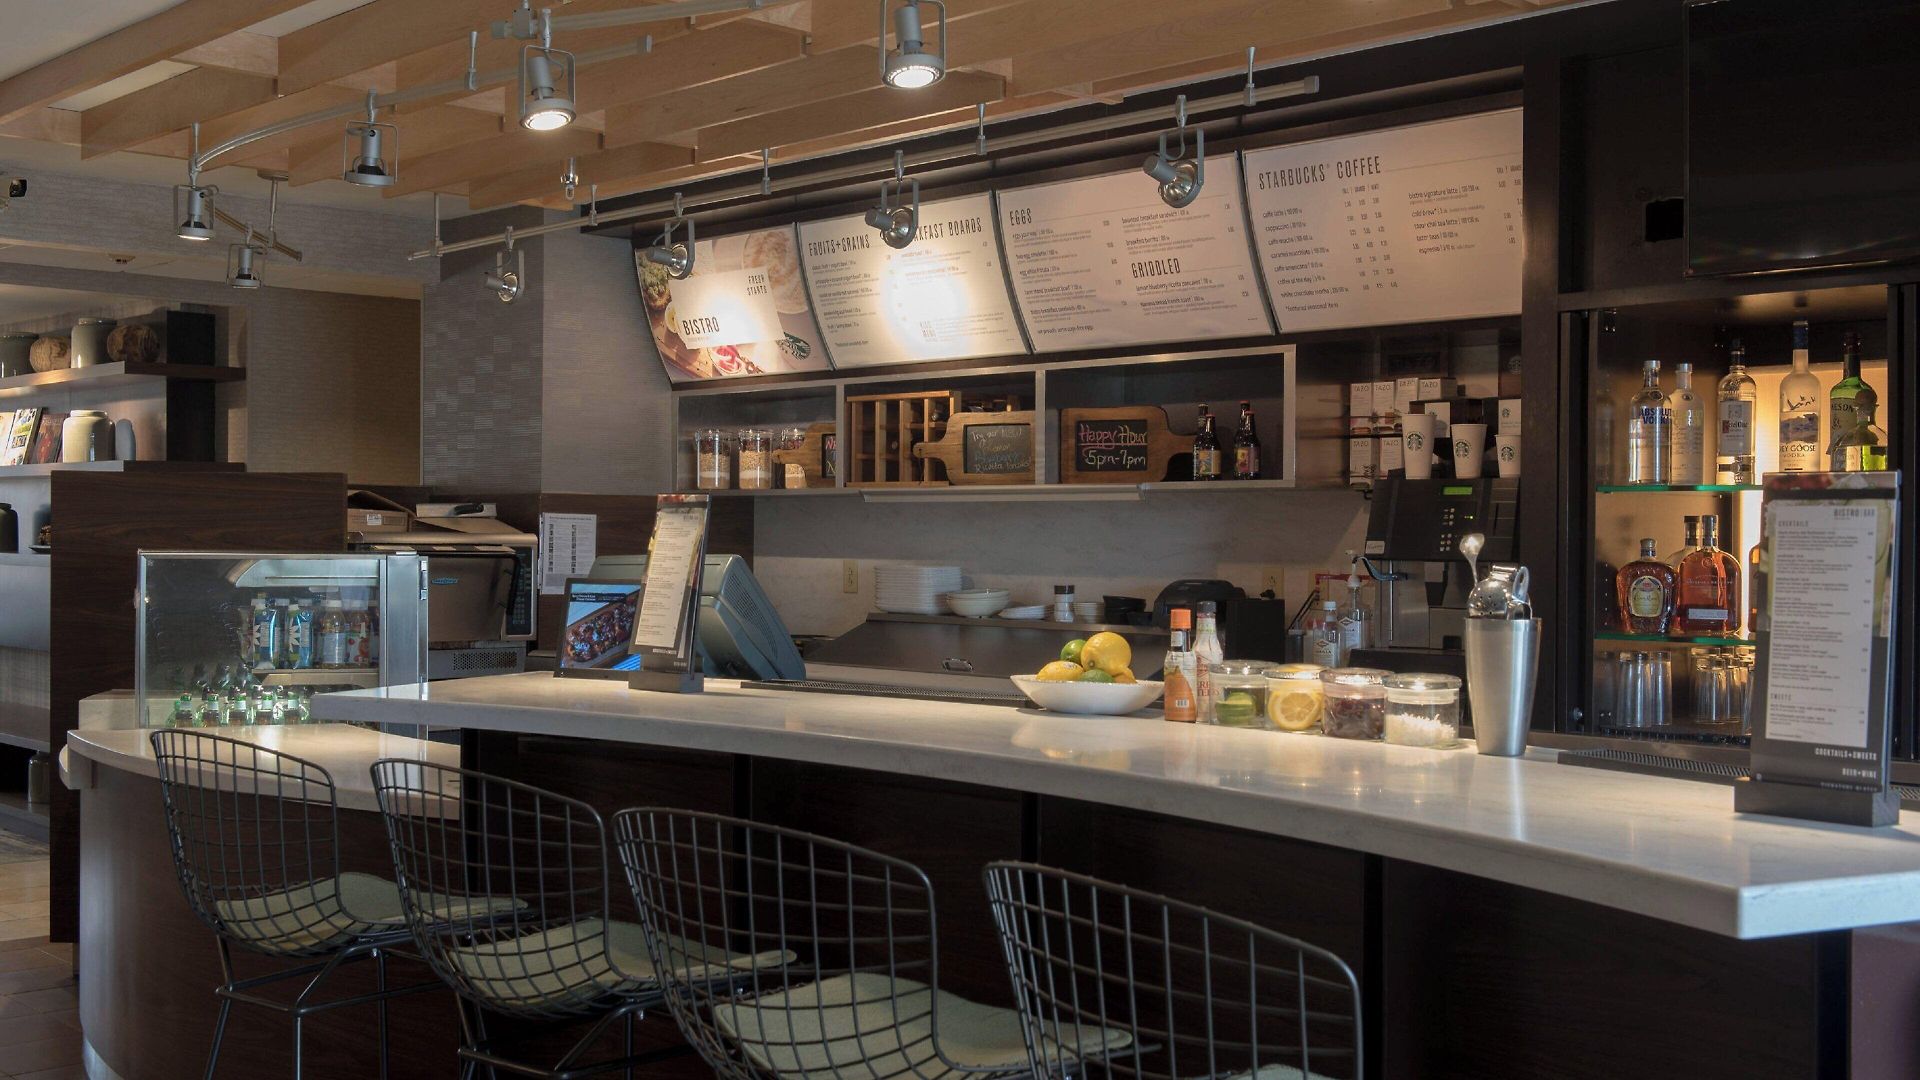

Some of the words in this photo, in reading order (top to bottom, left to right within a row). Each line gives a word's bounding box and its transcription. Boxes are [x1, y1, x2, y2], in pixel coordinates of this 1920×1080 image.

[1336, 155, 1382, 180] COFFEE
[1009, 207, 1032, 227] EGGS
[914, 222, 944, 242] KFAST
[948, 216, 983, 237] BOARDS
[1131, 257, 1181, 279] GRIDDLED
[748, 274, 765, 284] FRESH
[746, 285, 768, 296] STARTS
[682, 316, 720, 336] BISTRO
[1078, 423, 1118, 450] Happy
[1118, 425, 1148, 446] Hour
[1790, 444, 1816, 453] GOOSE
[1834, 508, 1860, 517] BISTRO
